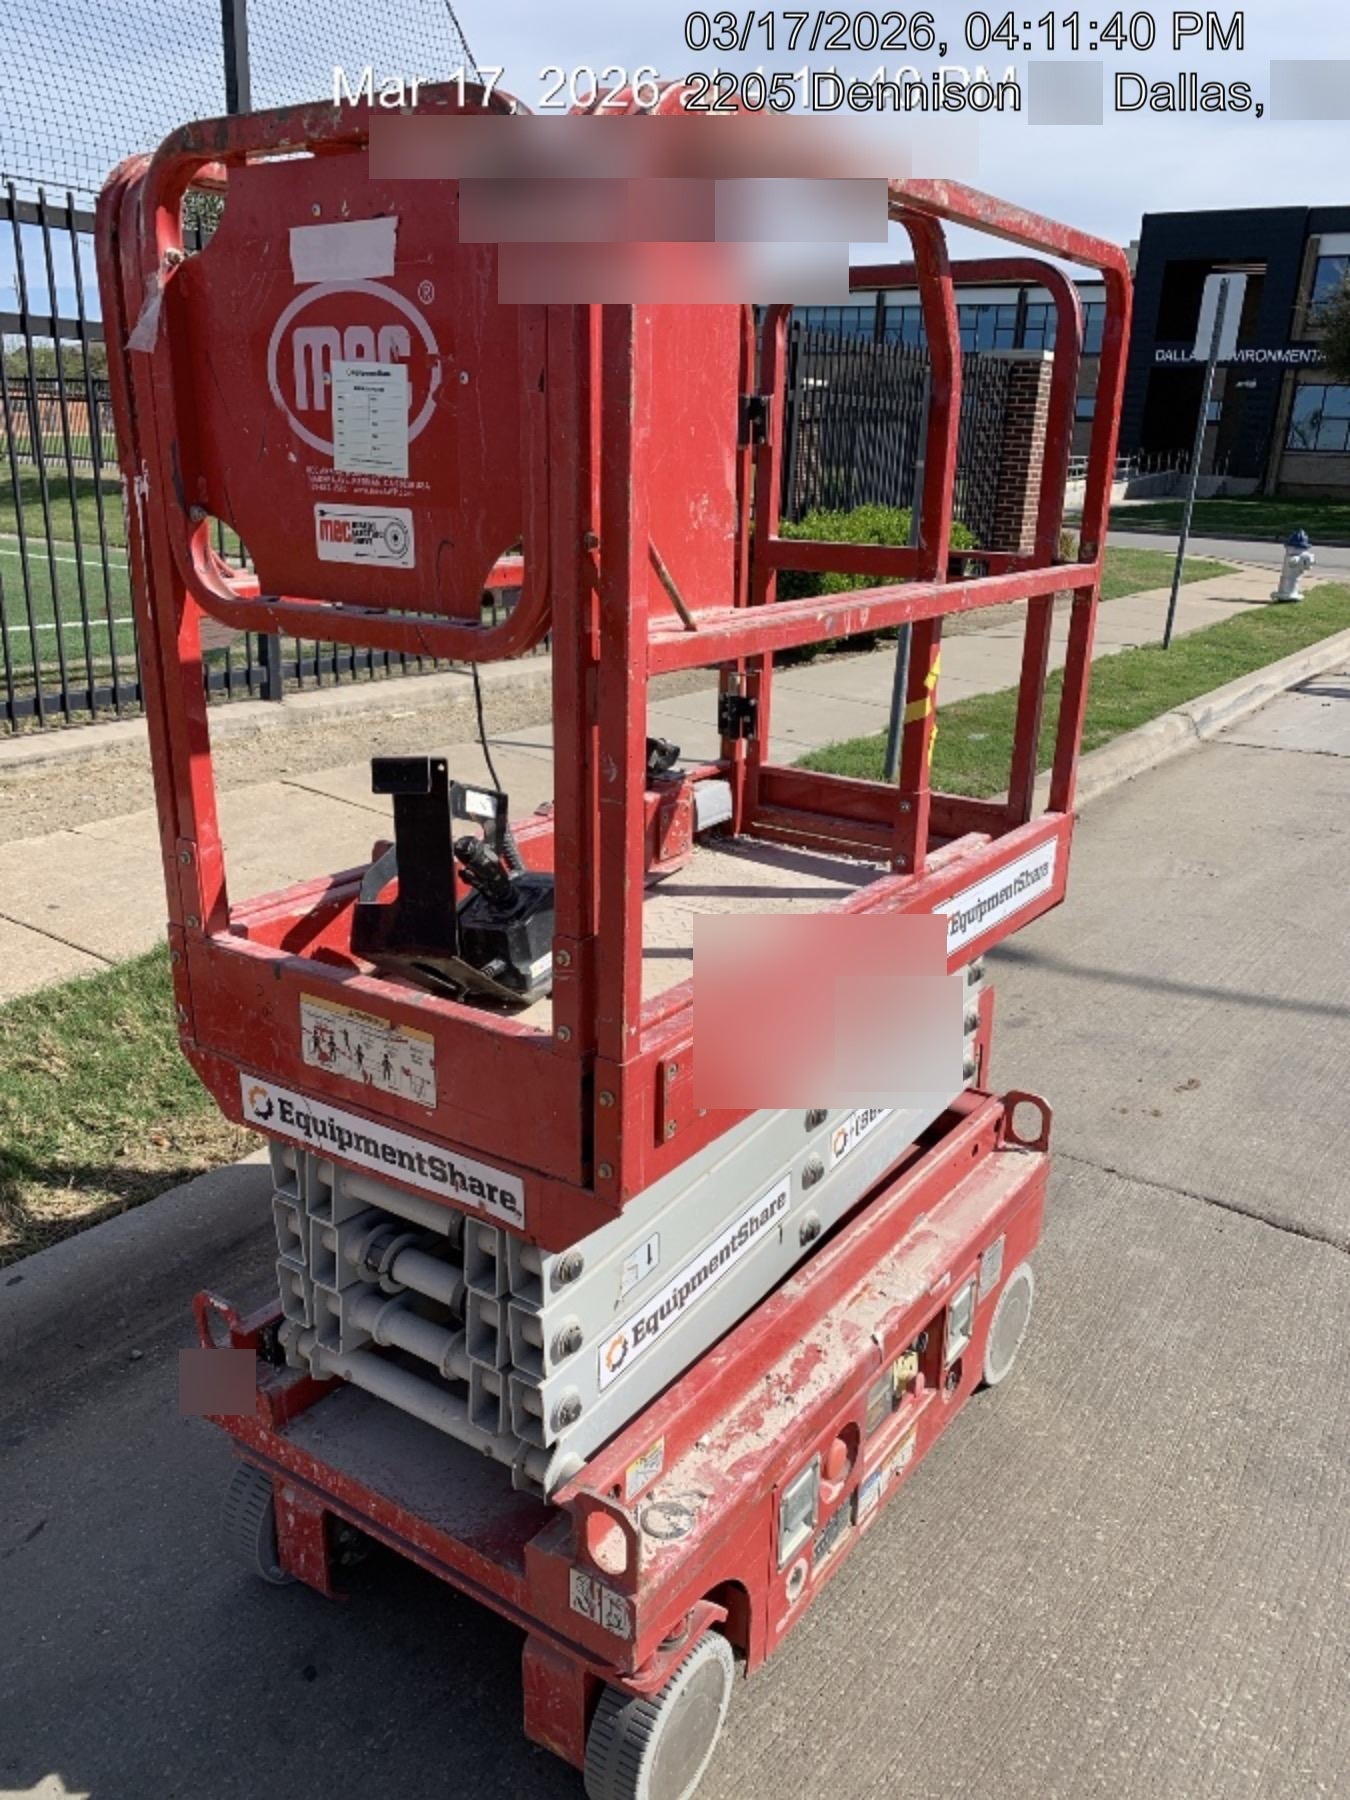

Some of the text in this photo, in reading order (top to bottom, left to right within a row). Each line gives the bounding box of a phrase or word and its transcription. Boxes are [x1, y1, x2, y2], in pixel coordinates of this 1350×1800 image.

[1155, 348, 1328, 363] DALLA VIRONMENT
[631, 1190, 787, 1348] EquipmentShare
